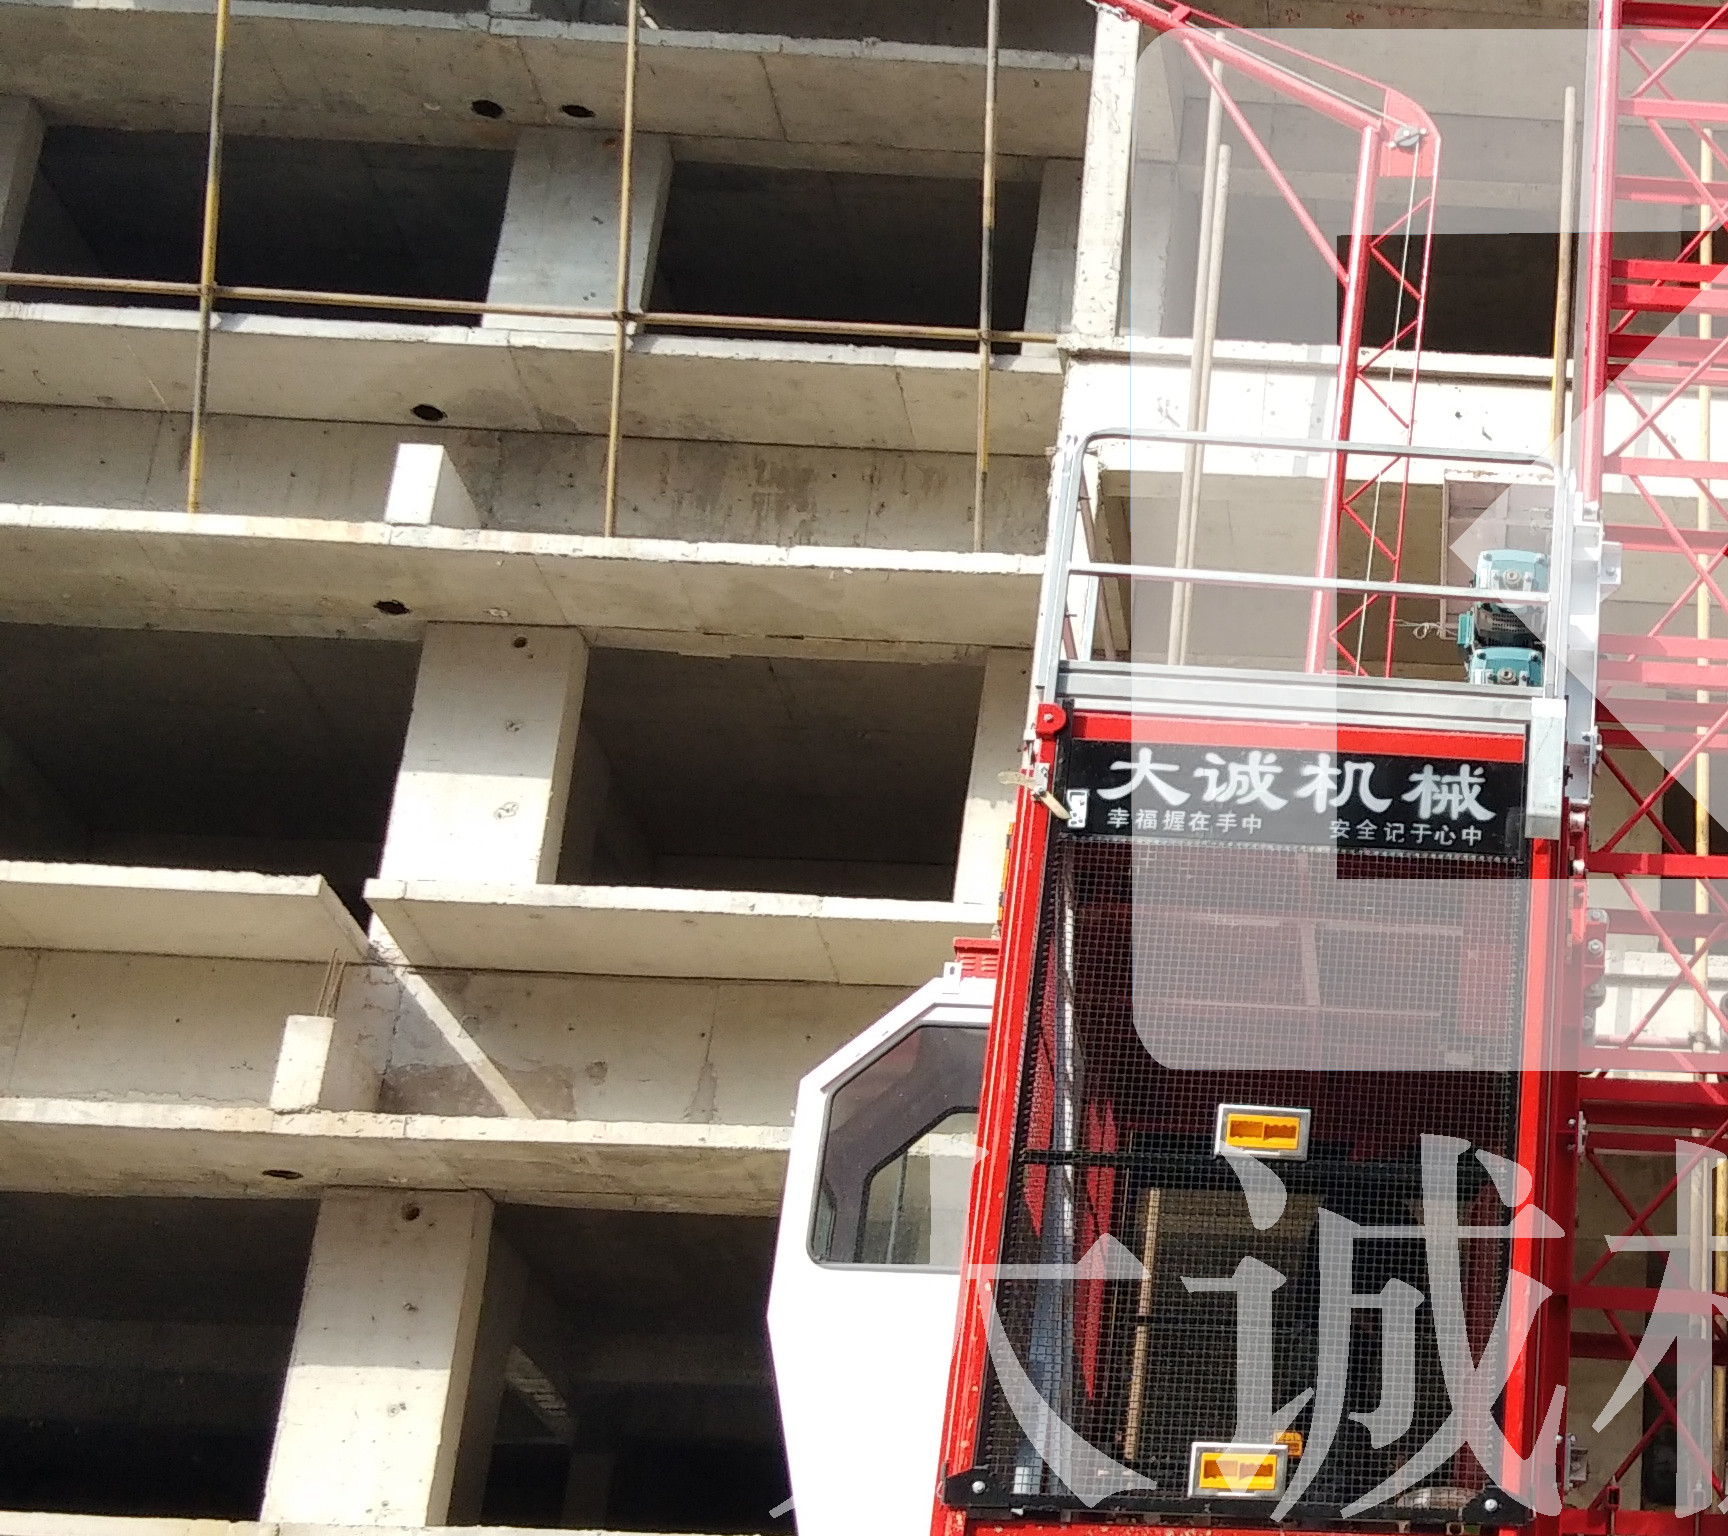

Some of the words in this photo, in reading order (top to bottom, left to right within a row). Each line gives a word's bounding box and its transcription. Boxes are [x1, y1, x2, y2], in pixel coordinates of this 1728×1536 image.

[1097, 747, 1496, 821] 大诚机械
[1107, 808, 1262, 835] 幸福握在手中
[1330, 818, 1483, 848] 安全记于心中
